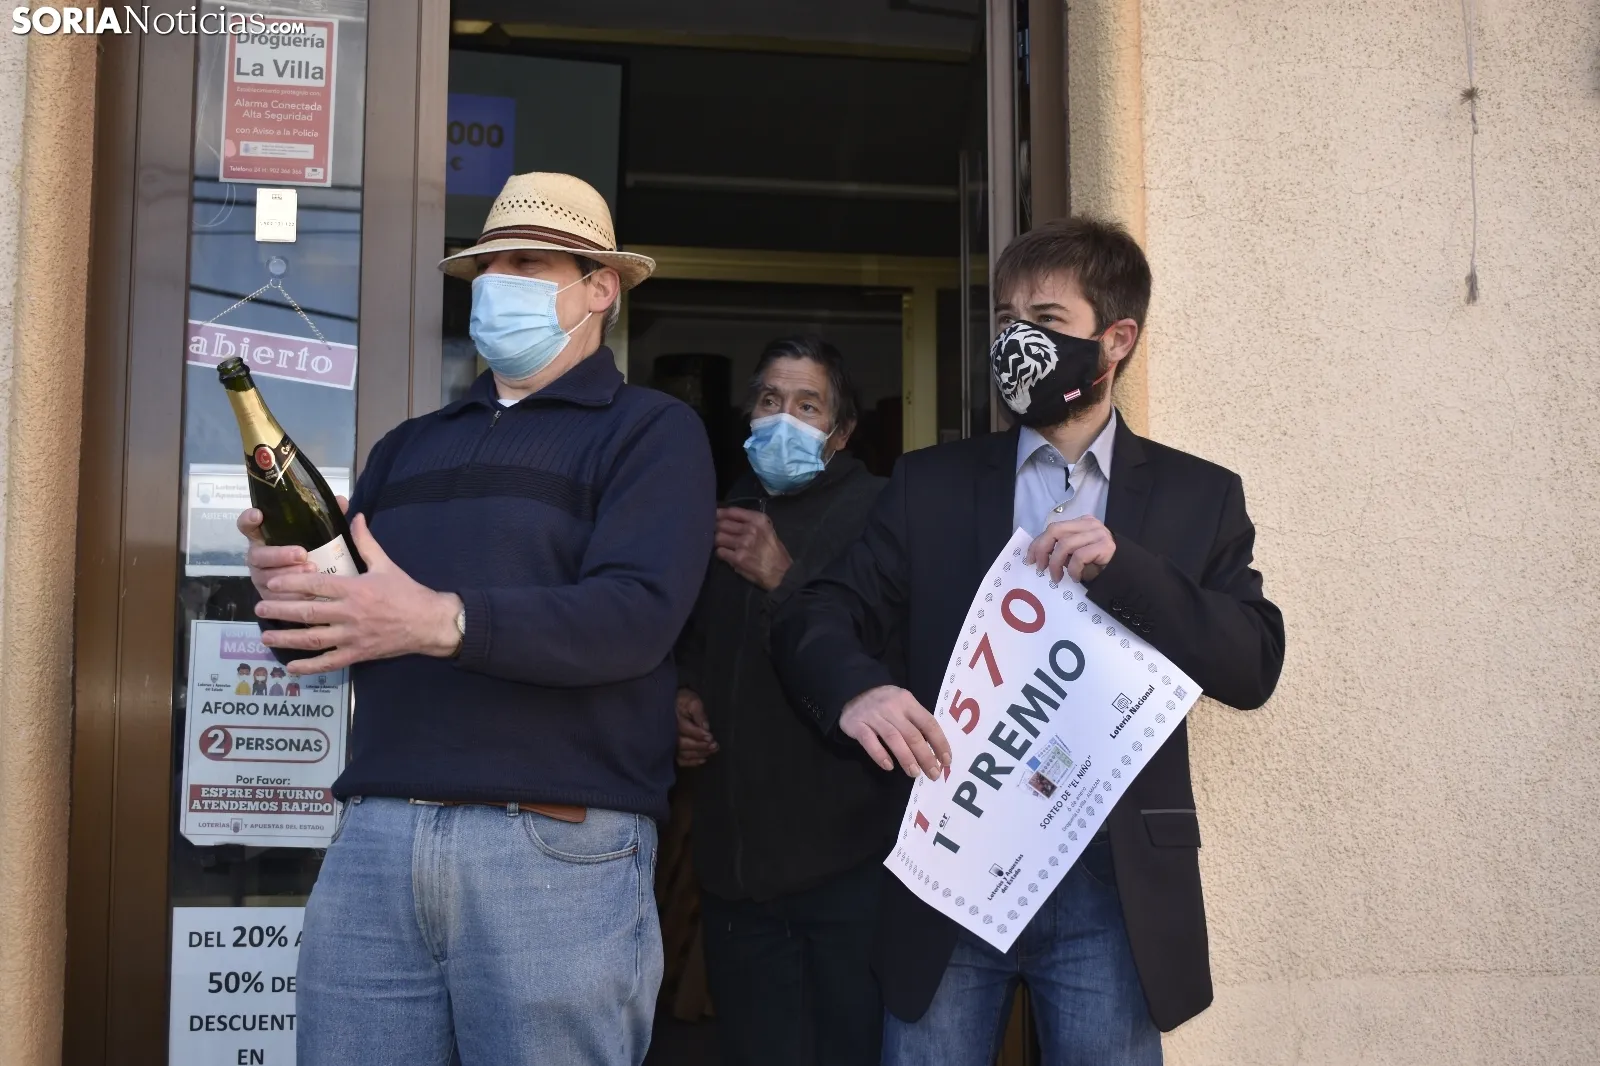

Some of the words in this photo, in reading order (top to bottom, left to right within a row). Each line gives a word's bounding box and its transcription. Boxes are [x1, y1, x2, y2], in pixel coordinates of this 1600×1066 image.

[237, 33, 325, 49] Droguería
[236, 57, 264, 77] La
[273, 59, 324, 80] Villa
[234, 98, 268, 108] Alarma
[271, 99, 322, 111] Conectada
[242, 109, 262, 119] Alta
[264, 110, 313, 122] Seguridad
[252, 127, 274, 135] Aviso
[283, 128, 291, 136] la
[188, 332, 333, 374] abierto
[223, 640, 270, 655] MASC
[201, 701, 260, 715] AFORO
[263, 700, 335, 718] MÁXIMO
[914, 588, 1046, 833] 1570
[1110, 715, 1131, 739] Lotería
[1129, 685, 1154, 715] Nacional
[952, 639, 1086, 818] PREMIO
[207, 729, 225, 754] 2
[235, 737, 323, 752] PERSONAS
[235, 774, 254, 785] Por
[256, 775, 291, 786] Favor:
[200, 787, 253, 799] ESPERE
[255, 788, 274, 799] SU
[277, 789, 324, 800] TURNO
[191, 800, 279, 812] ATENDEMOS
[283, 801, 333, 813] RAPIDO
[1040, 801, 1063, 829] SORTEO
[1061, 790, 1071, 801] DE
[188, 931, 226, 948] DEL
[232, 925, 288, 948] 20%
[207, 970, 265, 994] 50%
[189, 1014, 297, 1032] DESCUENT
[237, 1049, 264, 1066] EN
